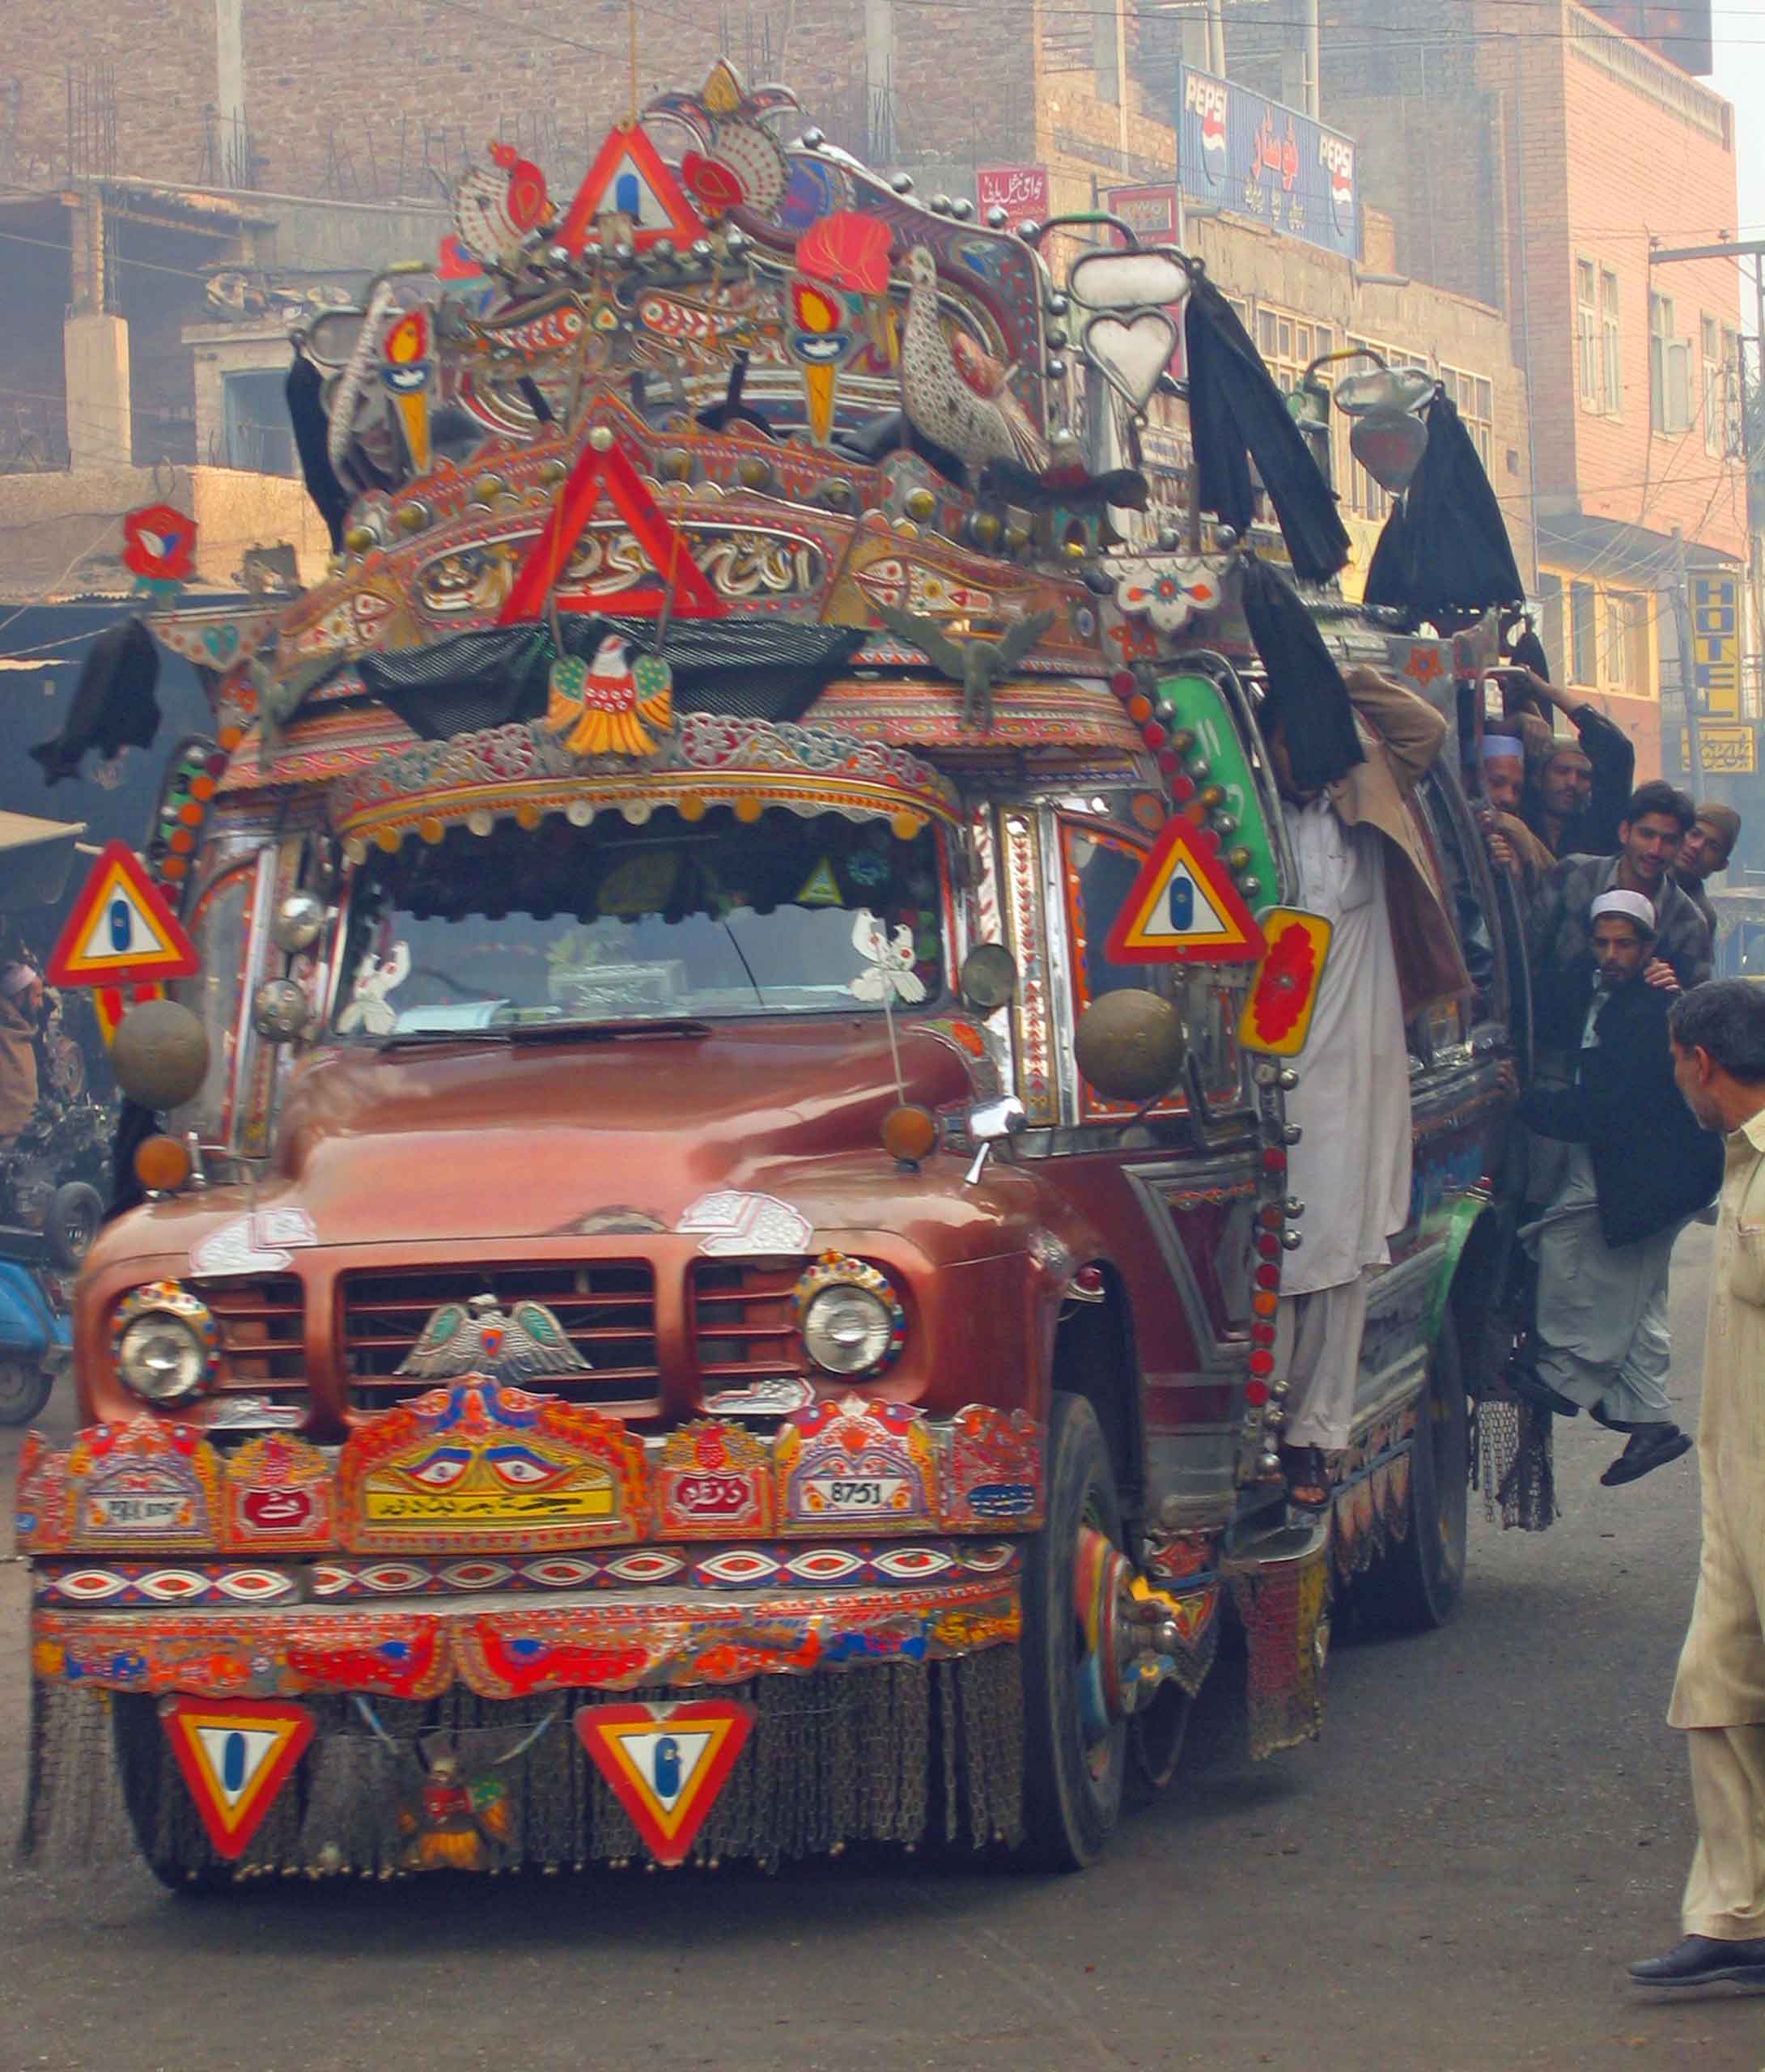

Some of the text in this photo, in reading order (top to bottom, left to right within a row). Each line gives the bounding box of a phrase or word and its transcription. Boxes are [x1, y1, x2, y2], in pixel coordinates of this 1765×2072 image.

[1186, 74, 1228, 123] PEPSI
[1319, 132, 1354, 180] PEPSI
[1695, 580, 1733, 717] HOTEL
[830, 1481, 881, 1505] 8751
